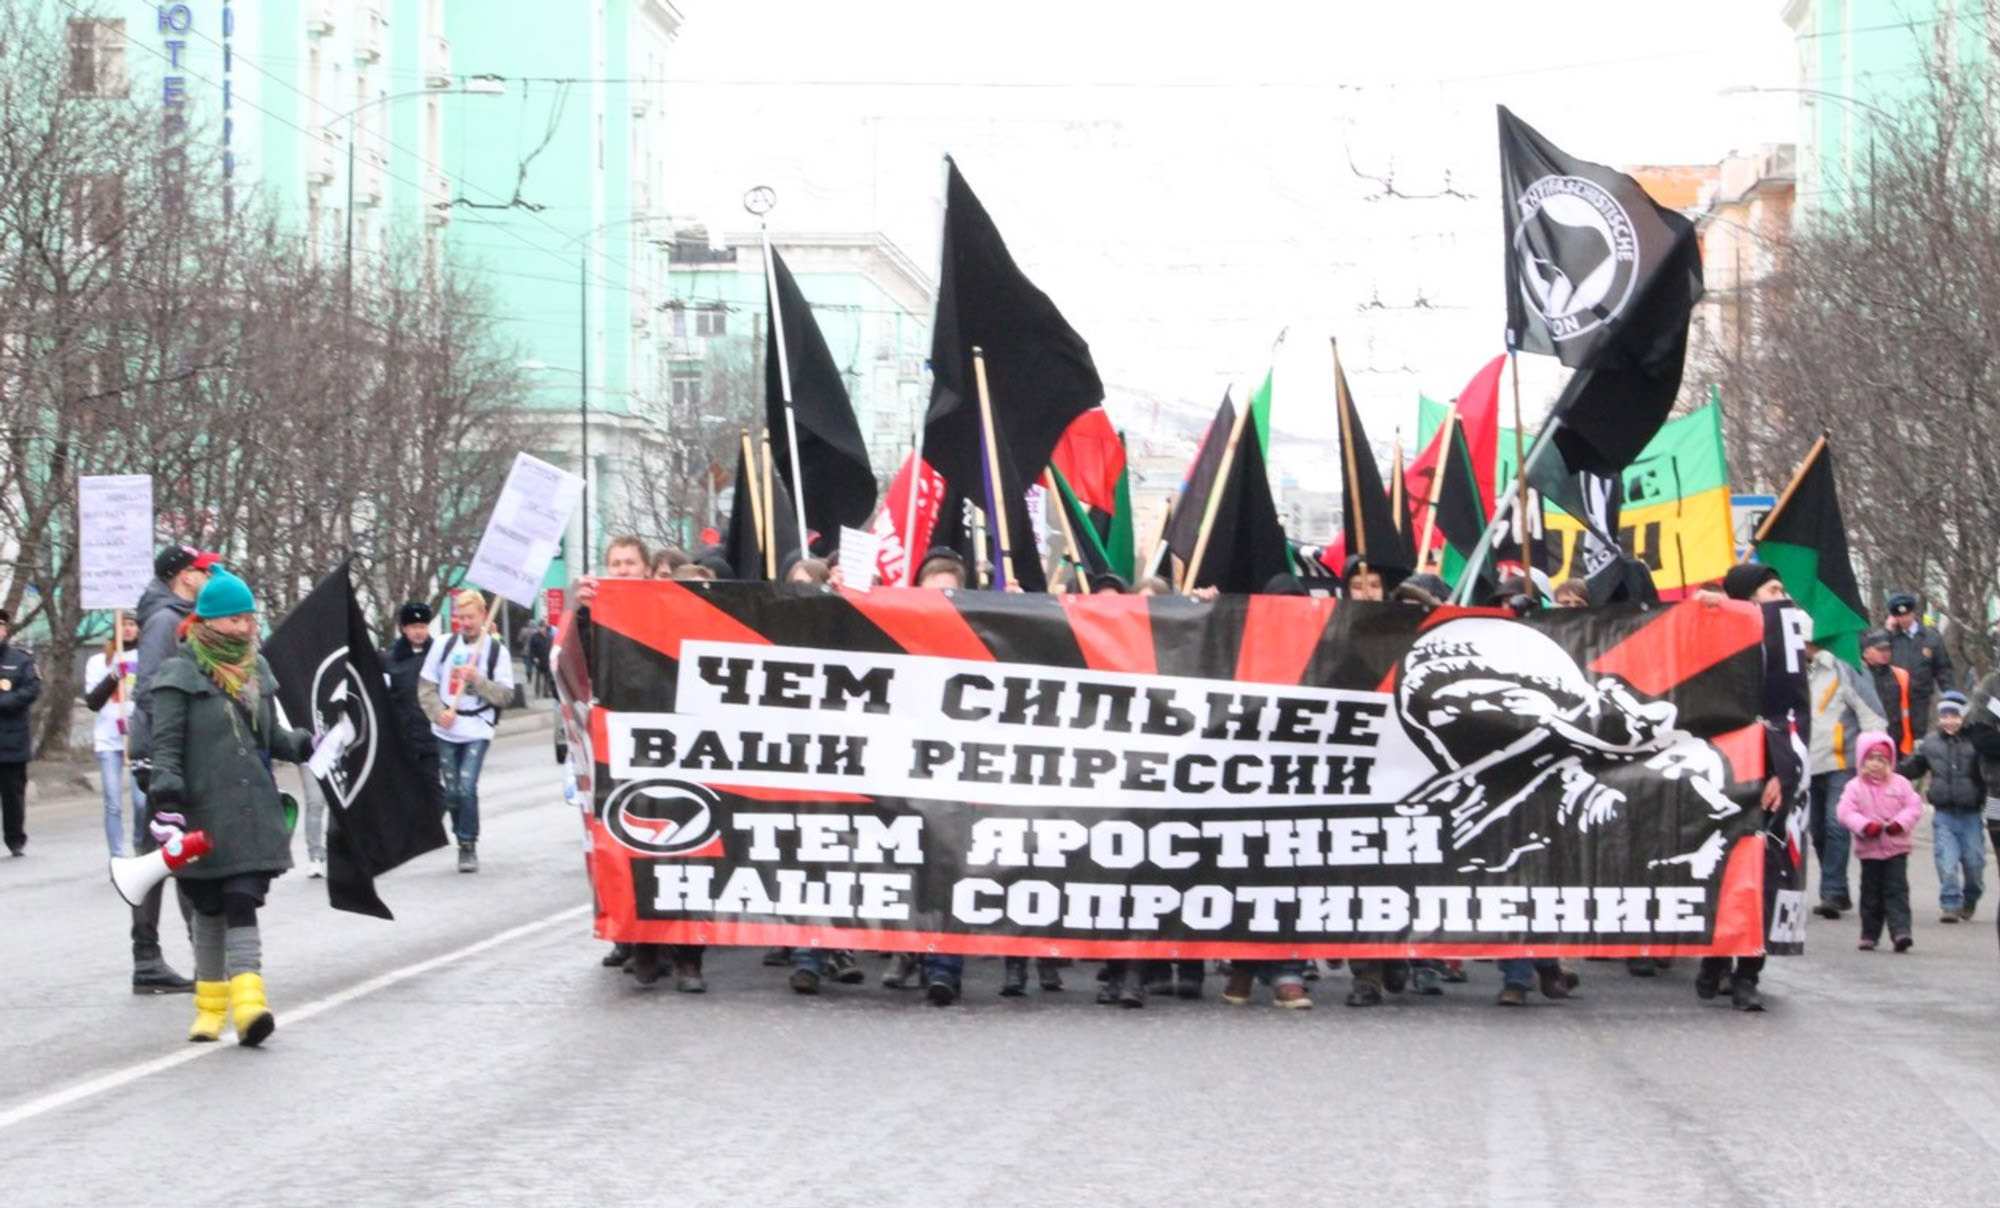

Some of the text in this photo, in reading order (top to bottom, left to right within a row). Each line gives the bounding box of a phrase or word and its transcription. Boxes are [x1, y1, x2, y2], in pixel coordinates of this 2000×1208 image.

[698, 656, 1387, 747] ЧЕМ СИЛЬНЕЕ
[629, 728, 1376, 795] ВАШИ РЕПРЕССИИ
[732, 803, 1444, 869] ТЕМ ЯРОСТНЕЙ
[653, 864, 912, 920] НАШЕ
[951, 877, 1706, 933] СОПРОТИВЛЕНИЕ
